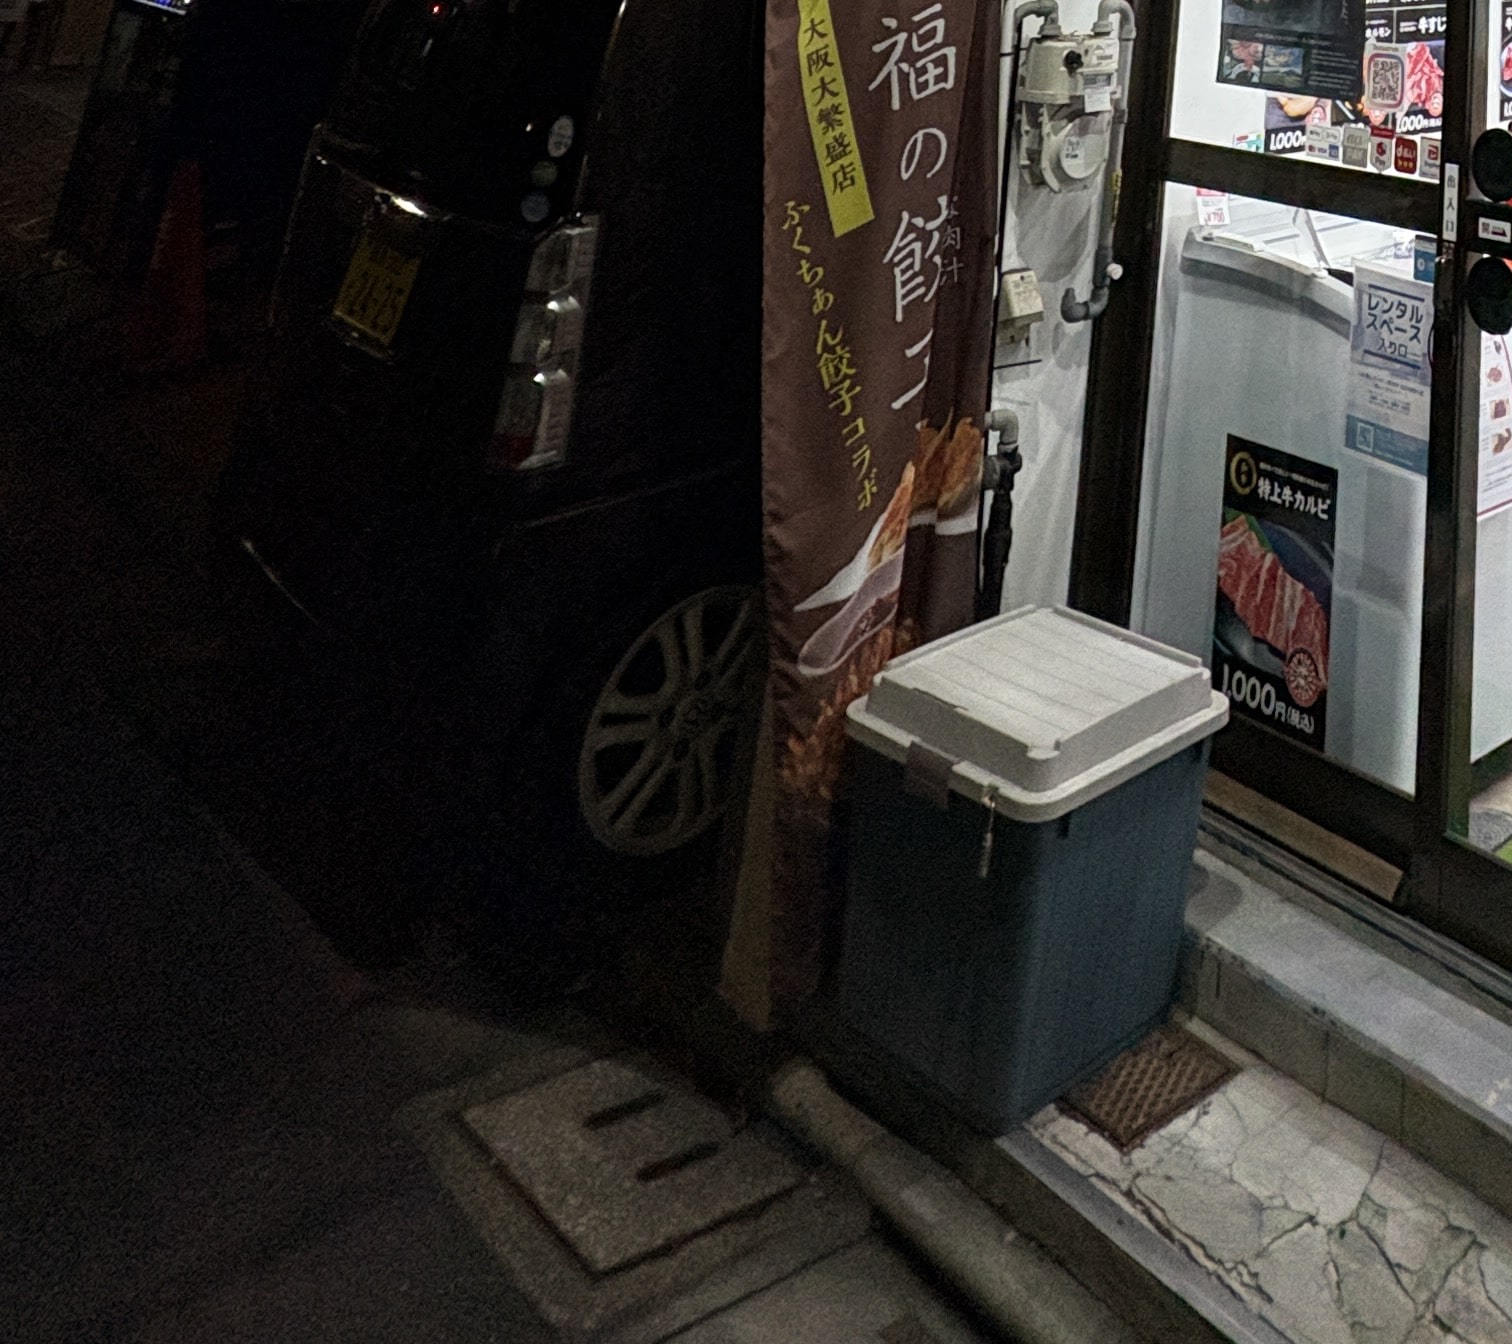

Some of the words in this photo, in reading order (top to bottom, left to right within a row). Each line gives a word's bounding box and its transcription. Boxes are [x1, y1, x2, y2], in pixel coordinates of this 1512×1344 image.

[803, 17, 857, 194] 大阪大繁盛店
[1367, 293, 1424, 324] レンタル
[1366, 312, 1422, 344] スペース
[1257, 476, 1331, 520] 特上牛カルビ
